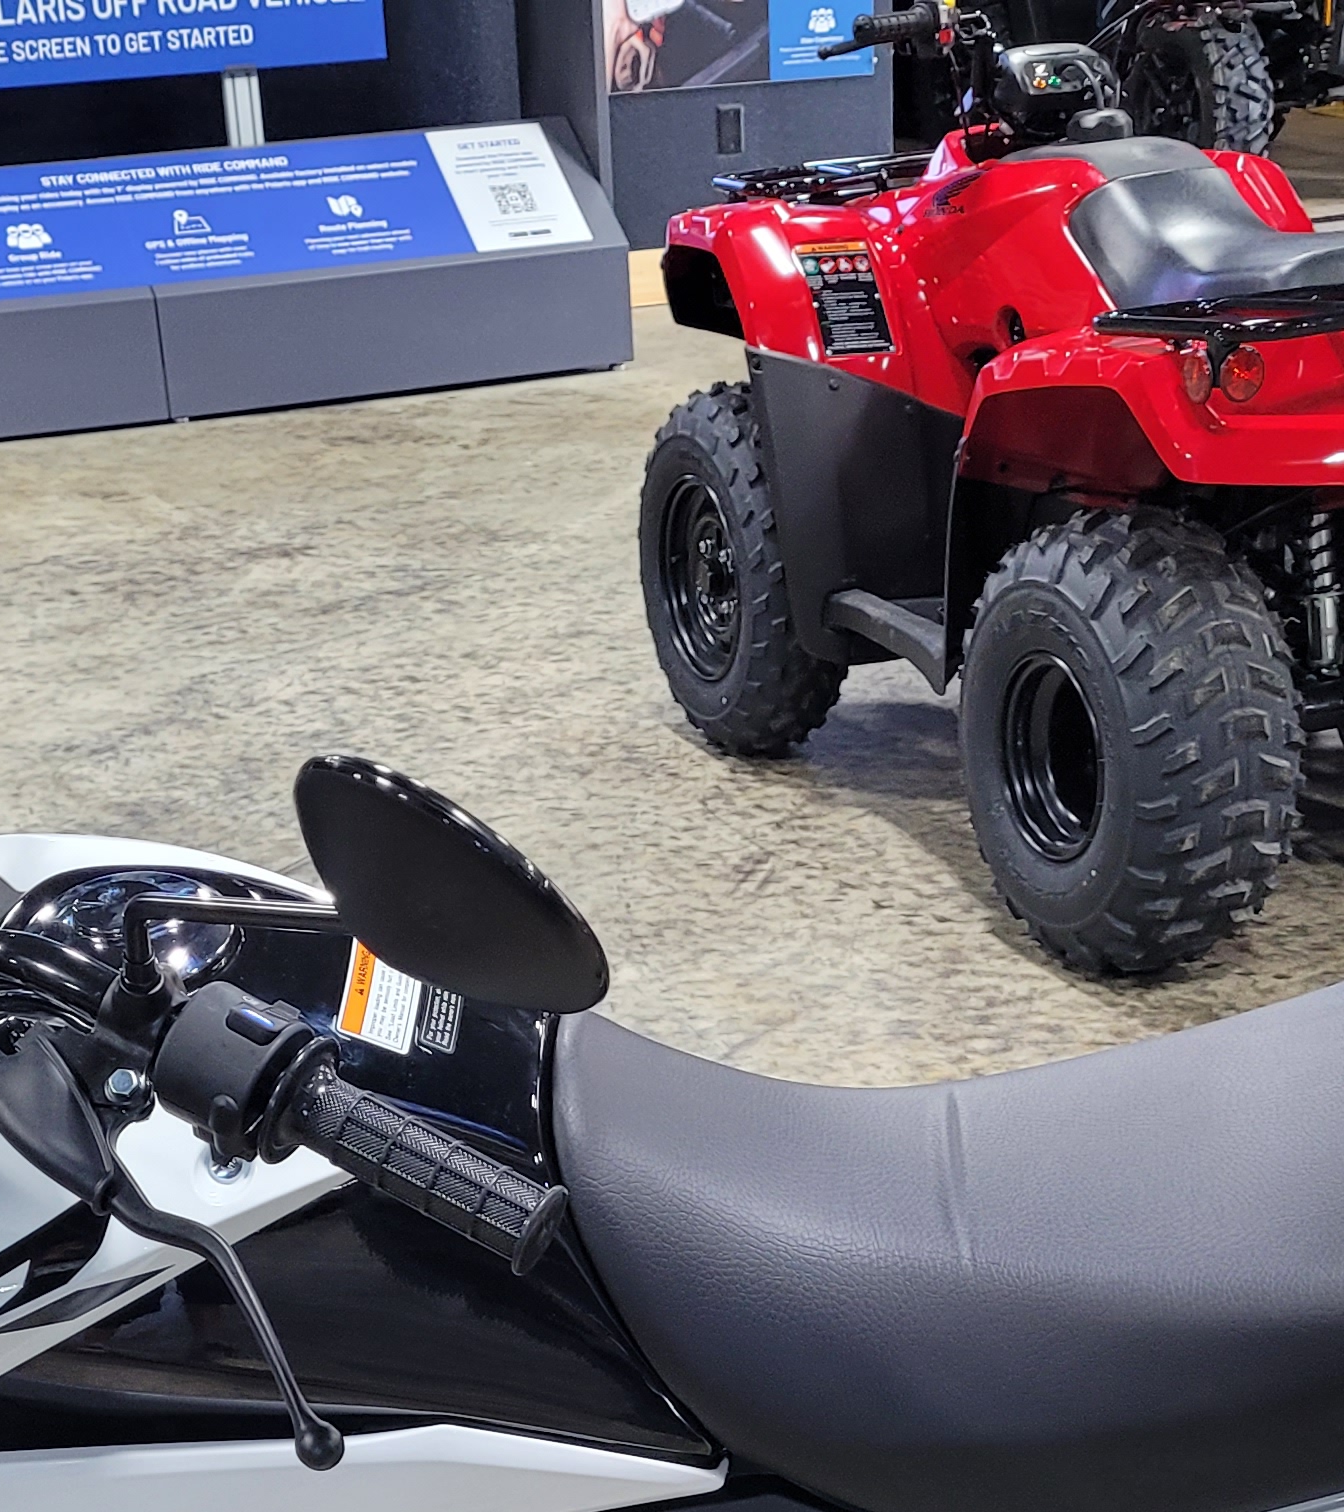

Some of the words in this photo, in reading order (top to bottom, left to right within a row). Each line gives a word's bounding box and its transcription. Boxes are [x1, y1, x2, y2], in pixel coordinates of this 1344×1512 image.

[11, 35, 91, 63] SCREEN
[94, 34, 121, 56] TO
[124, 30, 163, 54] GET
[166, 24, 254, 51] STARTED
[40, 174, 74, 188] STAY
[76, 168, 156, 184] CONNECTED
[156, 164, 191, 178] WITH
[192, 161, 223, 175] RIDE
[223, 156, 289, 172] COMMAND
